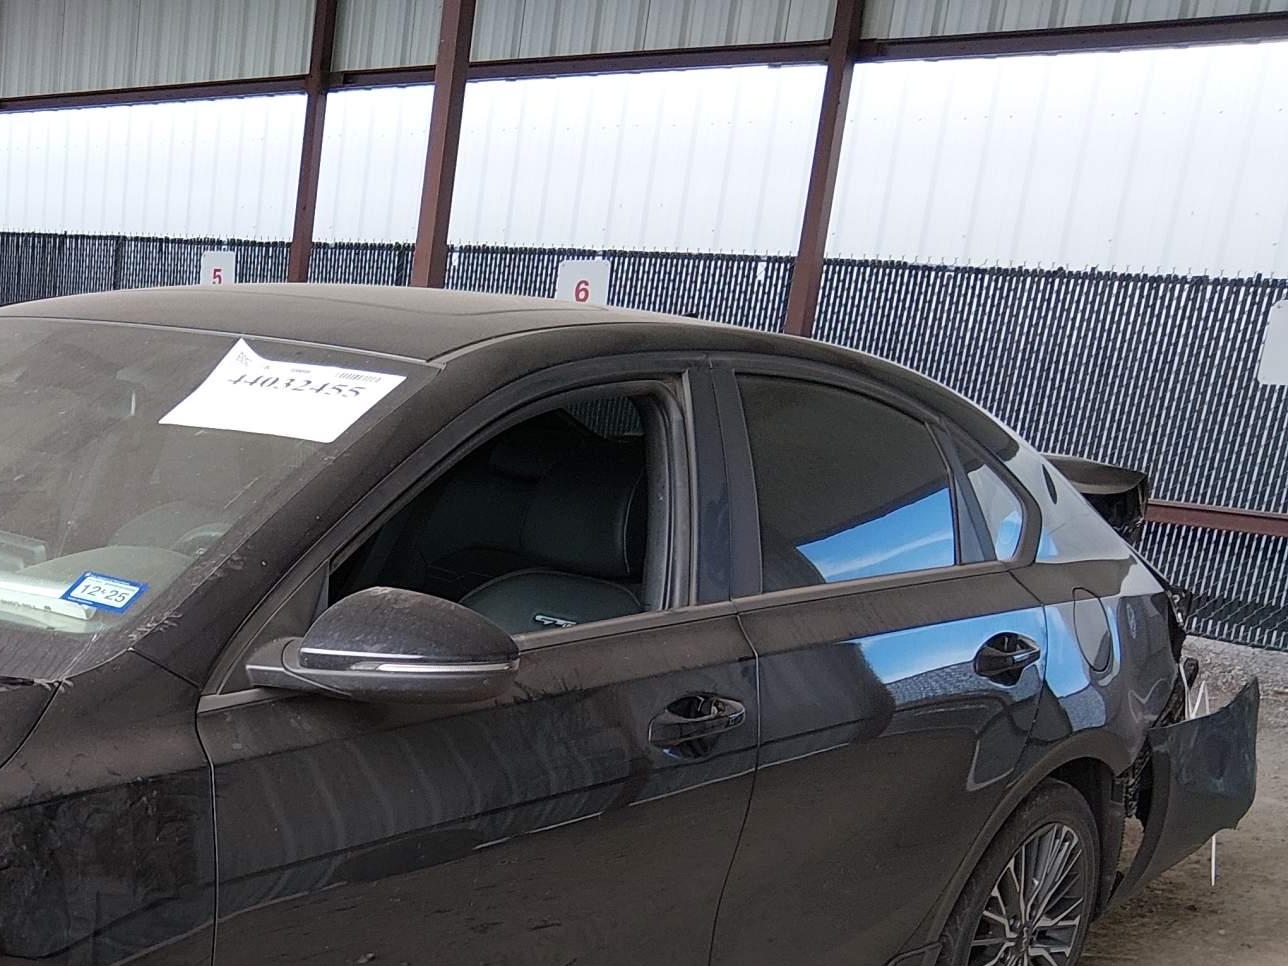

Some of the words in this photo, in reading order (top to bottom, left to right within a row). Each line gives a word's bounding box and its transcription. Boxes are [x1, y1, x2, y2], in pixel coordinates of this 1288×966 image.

[212, 268, 222, 285] 5
[575, 279, 589, 302] 6
[228, 373, 366, 398] 44032455
[80, 584, 102, 597] 12
[103, 590, 130, 603] 25
